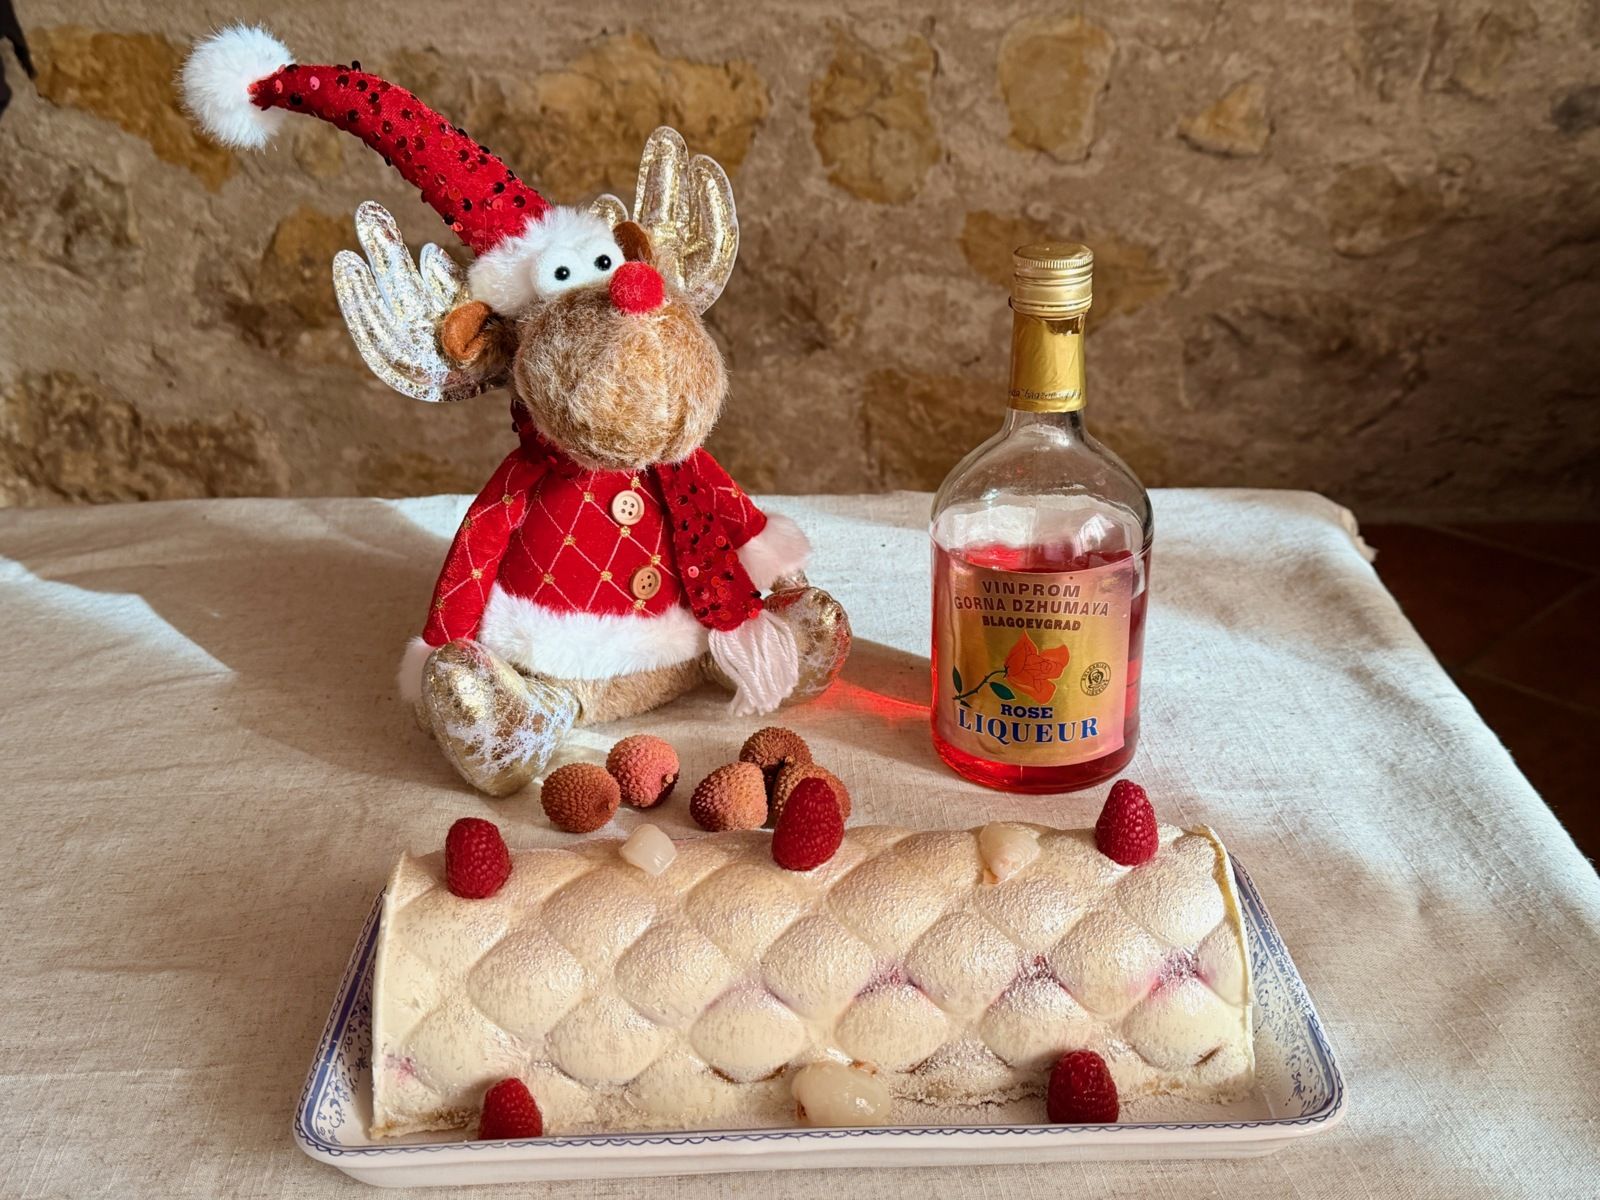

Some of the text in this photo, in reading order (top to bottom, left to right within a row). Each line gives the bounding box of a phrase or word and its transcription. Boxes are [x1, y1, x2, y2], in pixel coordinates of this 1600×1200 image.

[982, 581, 1081, 597] VINPROM
[955, 597, 1109, 616] GORNA DZHUMAYA
[983, 616, 1081, 631] BLAGOEVGRAD
[1001, 705, 1053, 718] ROSE
[959, 708, 1098, 745] LIQUEUR
